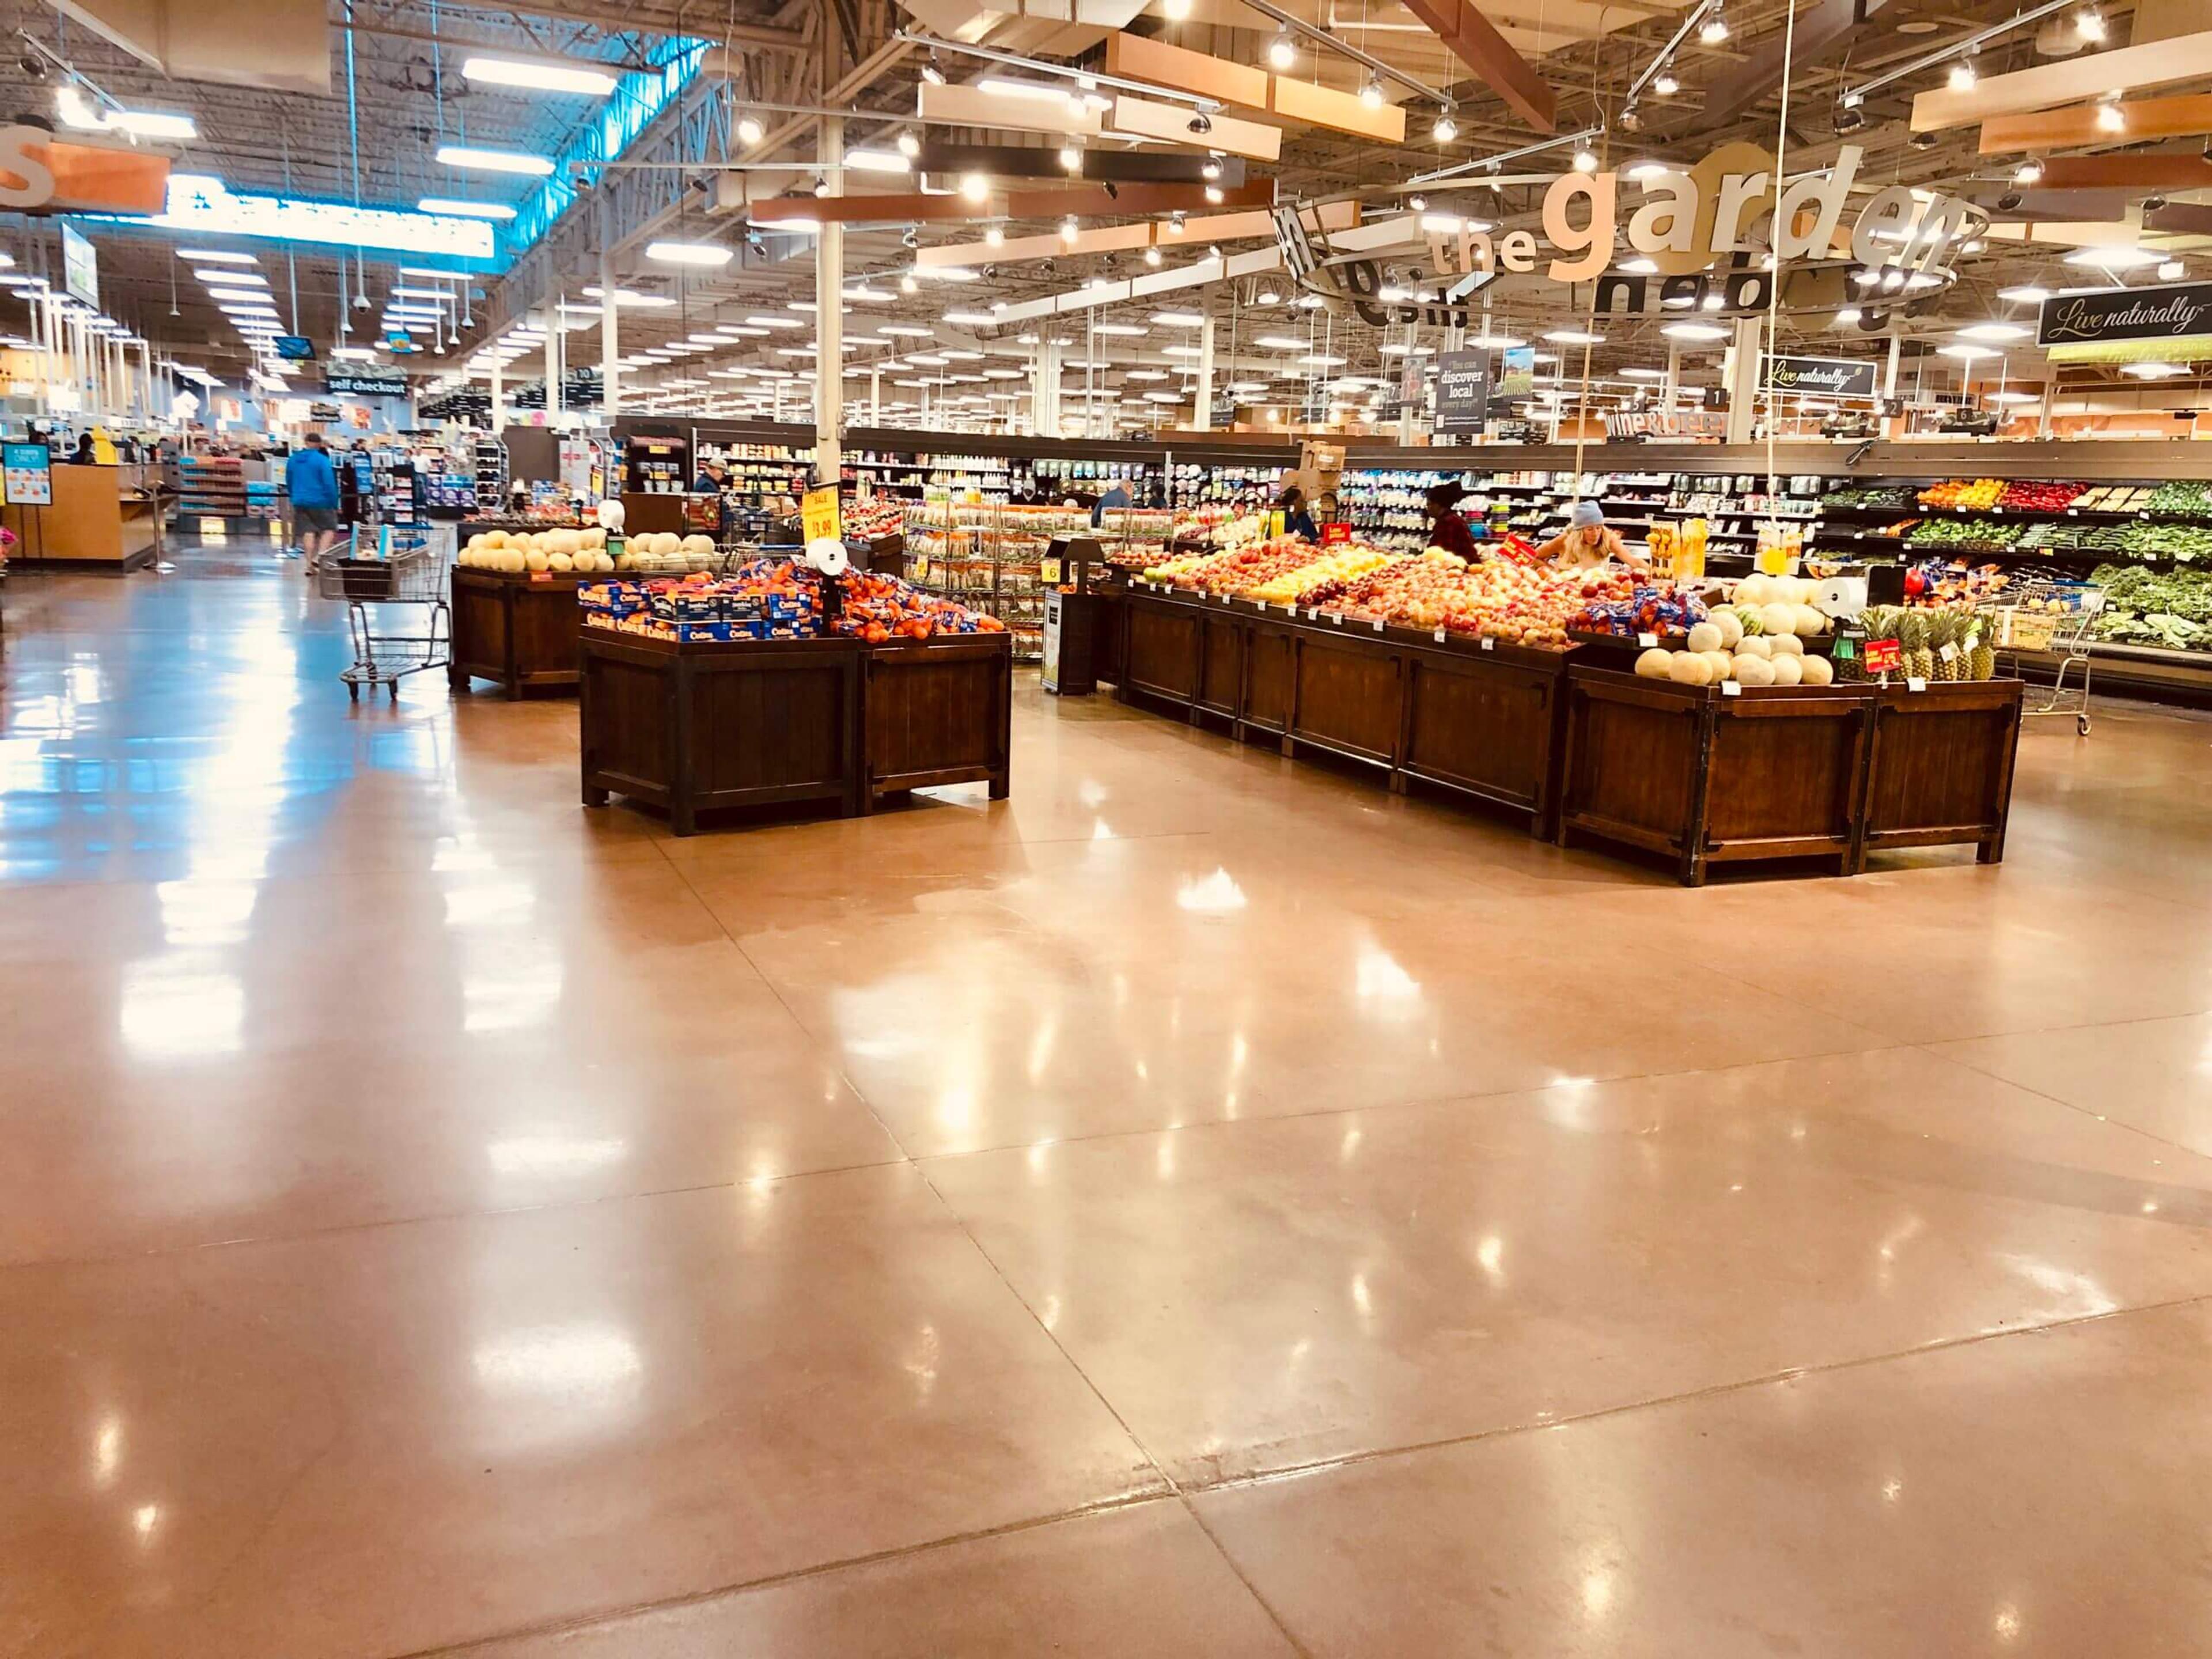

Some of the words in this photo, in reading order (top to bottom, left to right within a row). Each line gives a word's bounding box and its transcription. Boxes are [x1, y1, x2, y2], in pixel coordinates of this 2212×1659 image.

[1427, 217, 1537, 275] the
[1542, 145, 1963, 282] garden
[2047, 298, 2103, 339] Live
[2103, 296, 2204, 334] naturally
[1441, 370, 1483, 384] discover
[1764, 360, 1797, 387] Live
[1796, 367, 1850, 392] naturally
[329, 379, 351, 390] self
[353, 380, 406, 393] checkout
[1448, 383, 1473, 398] local
[1714, 390, 1719, 404] 1
[1889, 402, 1897, 415] 2
[1960, 411, 1967, 422] 6
[814, 494, 827, 505] SALE
